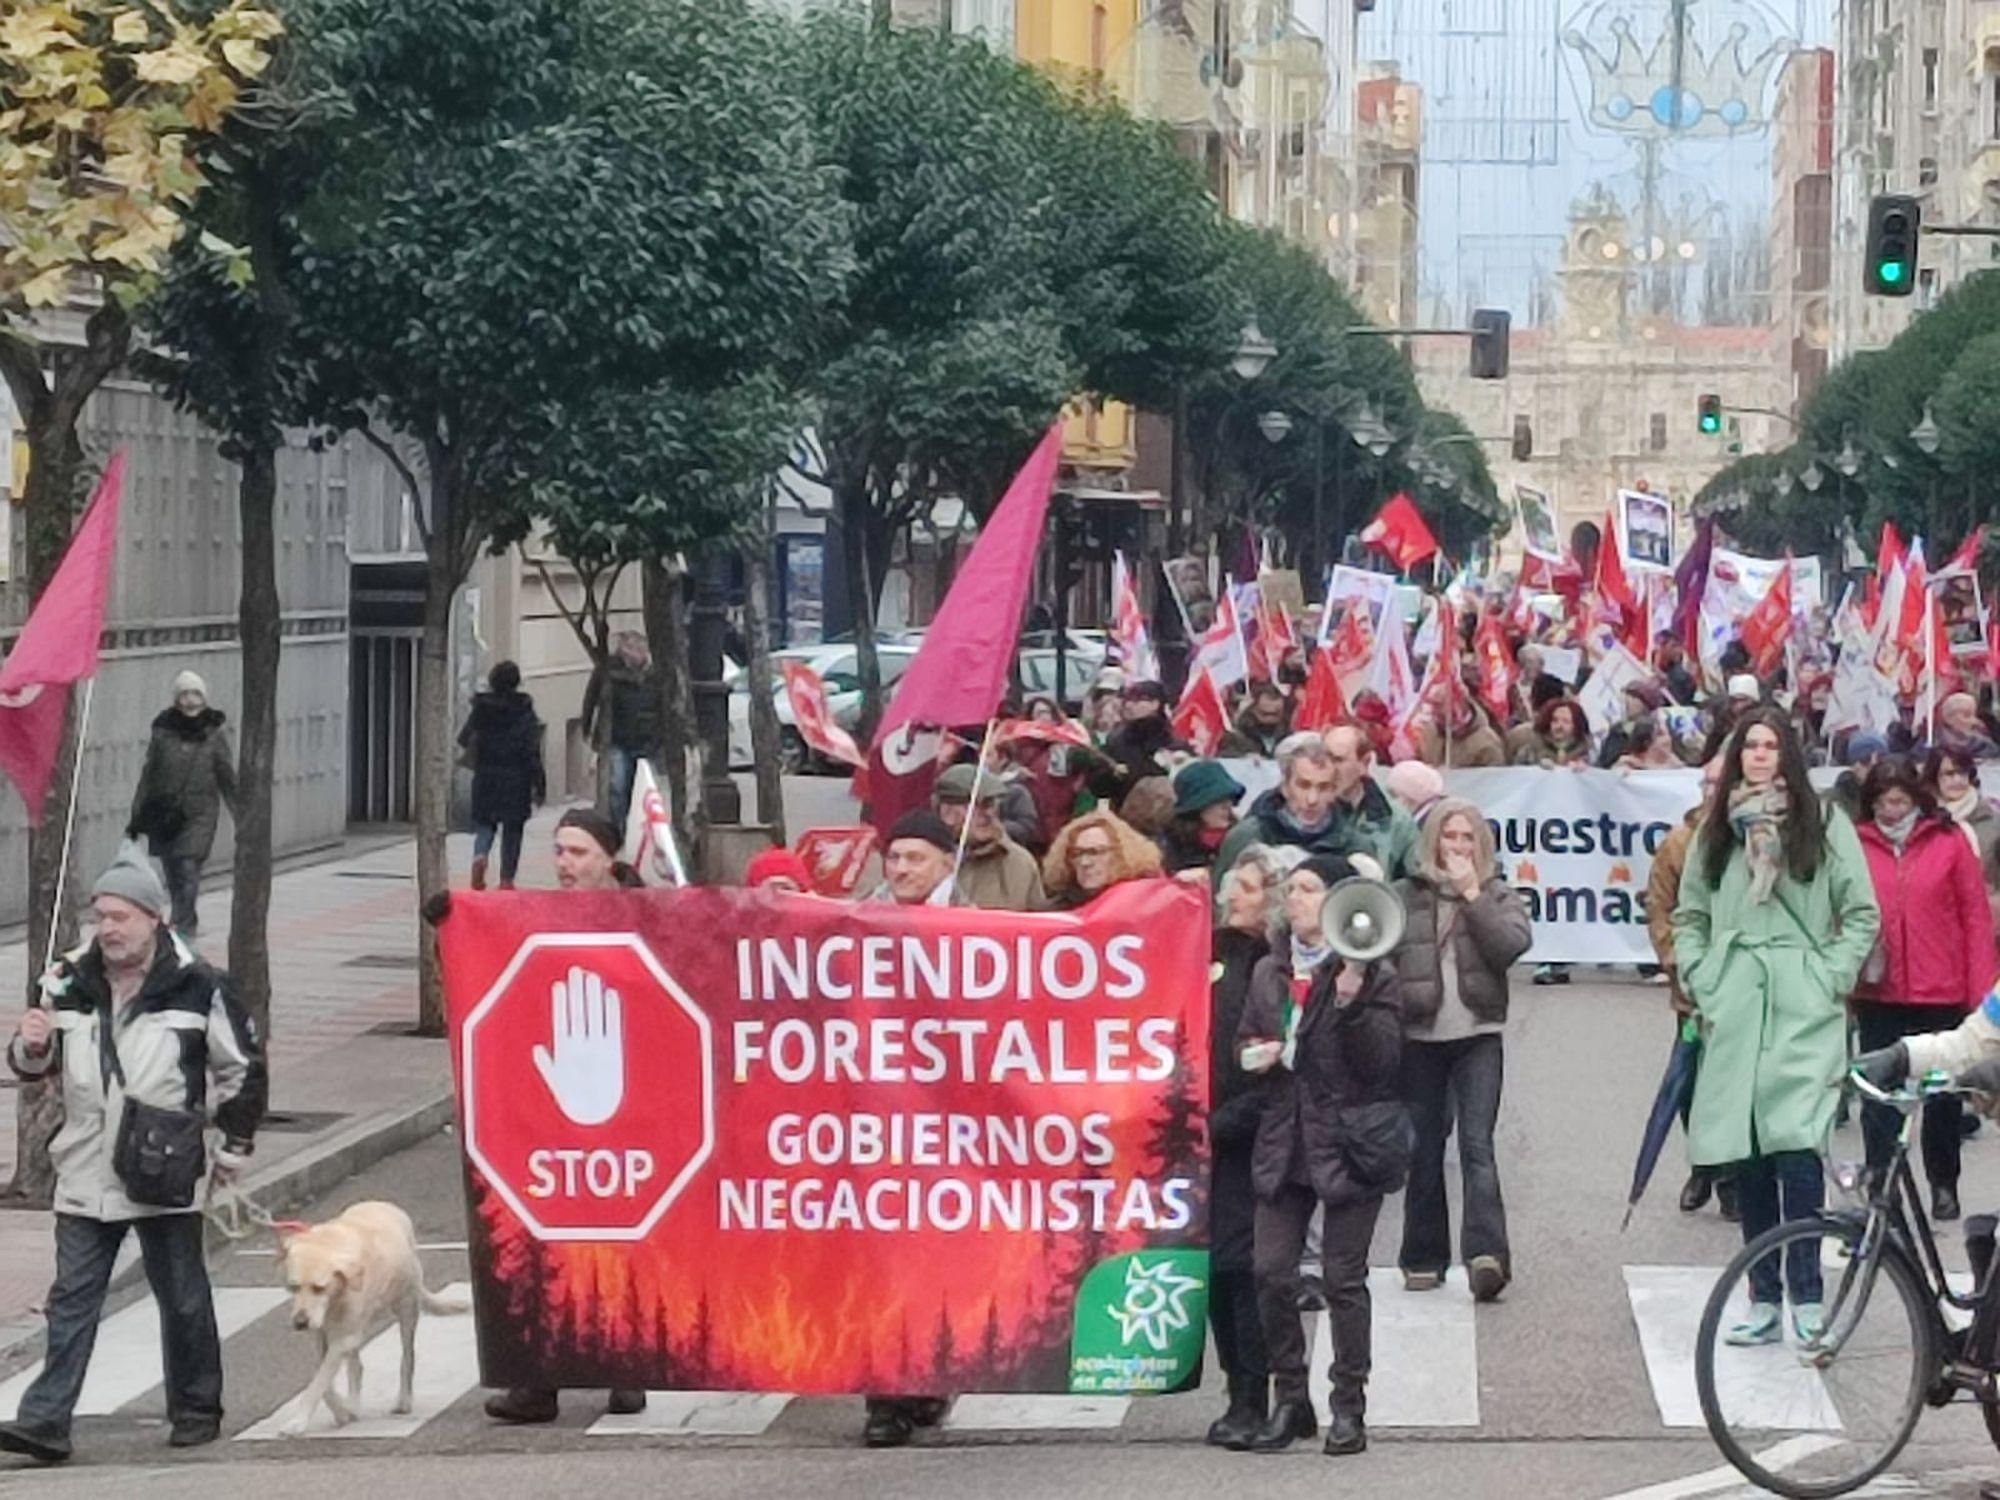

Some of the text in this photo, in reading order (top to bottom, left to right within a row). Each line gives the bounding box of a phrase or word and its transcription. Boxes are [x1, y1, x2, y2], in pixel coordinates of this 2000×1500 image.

[737, 934, 1146, 1000] INCENDIOS
[733, 1018, 1176, 1084] FORESTALES
[768, 1113, 1114, 1166] GOBIERNOS
[527, 1149, 654, 1197] STOP
[719, 1178, 1191, 1232] NEGACIONISTAS
